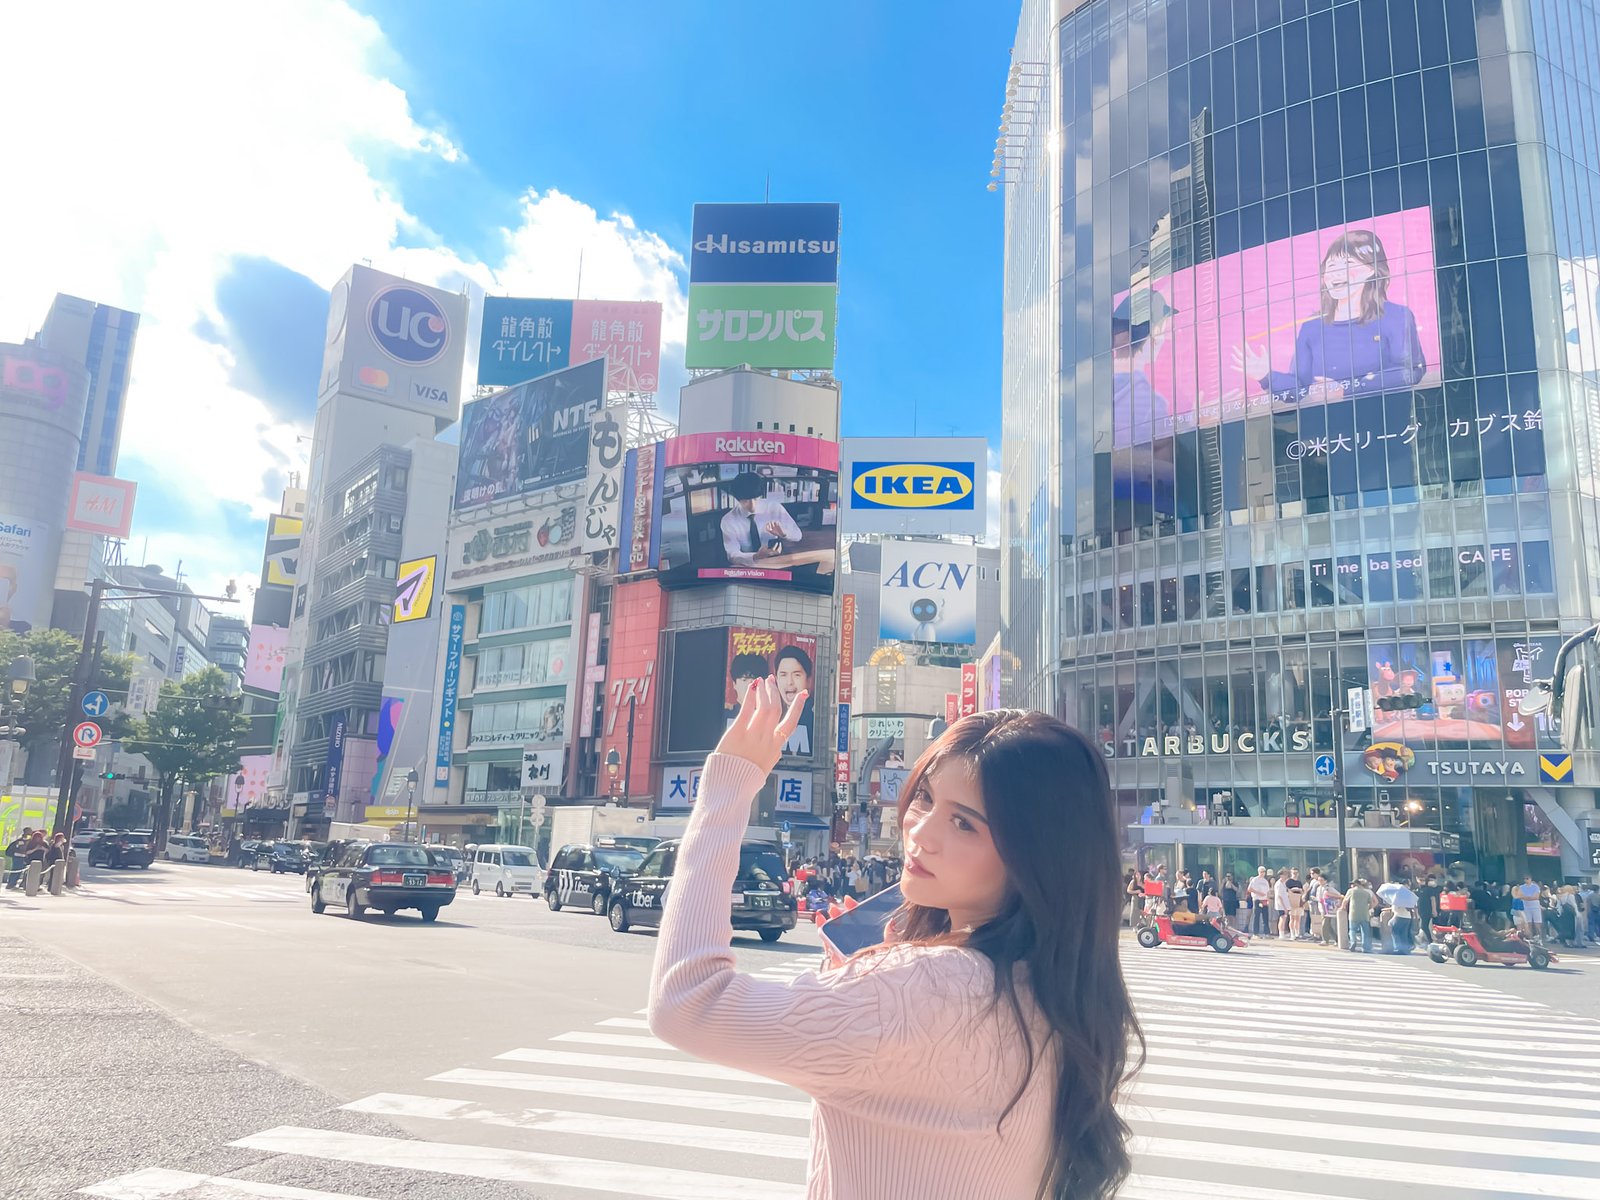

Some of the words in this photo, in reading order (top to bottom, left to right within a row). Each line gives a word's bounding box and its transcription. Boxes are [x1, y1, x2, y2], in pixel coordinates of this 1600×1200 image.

[694, 234, 836, 254] Hisamitsu
[501, 314, 554, 339] 龍角散
[591, 319, 643, 343] 龍角散
[696, 309, 826, 342] サロンパス
[414, 383, 449, 403] VISA
[715, 437, 785, 454] Rakuten
[585, 411, 623, 546] もんじゃ
[864, 476, 964, 494] IKEA
[1458, 548, 1511, 564] CAFE
[883, 560, 974, 591] ACN
[1104, 731, 1309, 757] STARBUCKS
[1427, 761, 1526, 776] TSUTAYA
[779, 778, 803, 803] 店
[632, 889, 654, 909] Uber
